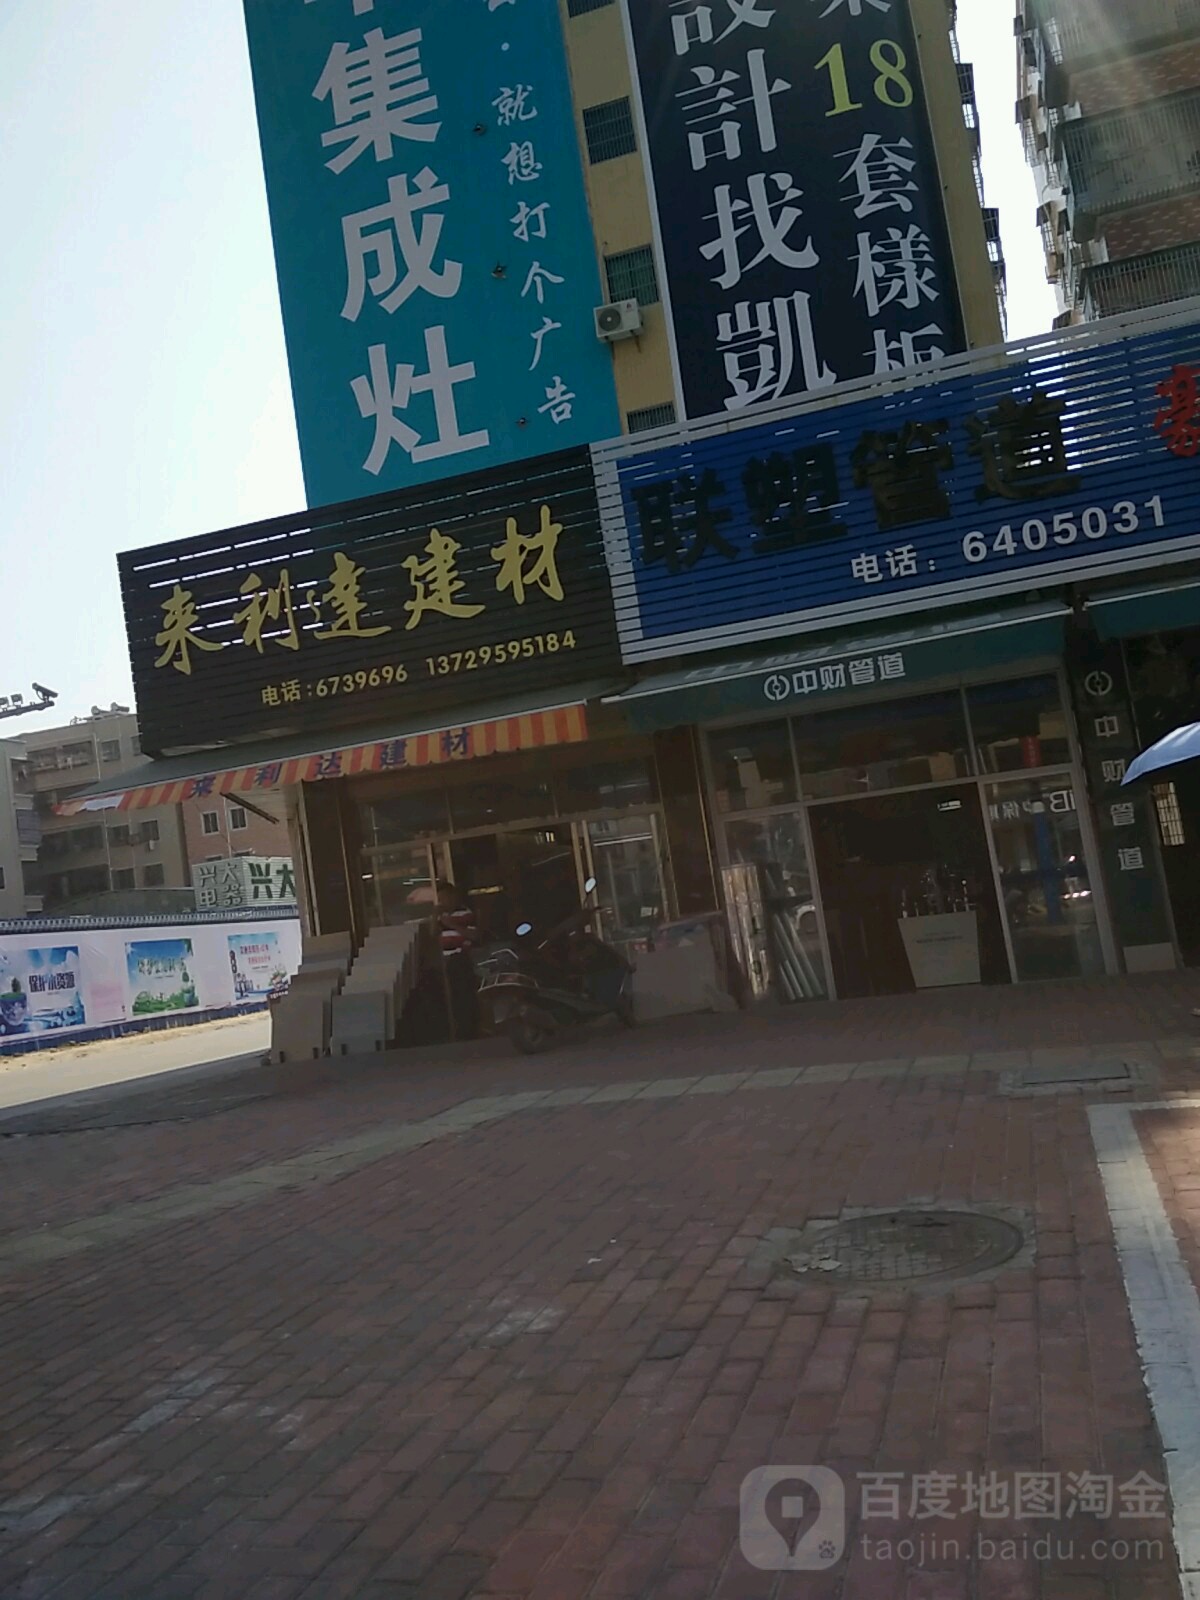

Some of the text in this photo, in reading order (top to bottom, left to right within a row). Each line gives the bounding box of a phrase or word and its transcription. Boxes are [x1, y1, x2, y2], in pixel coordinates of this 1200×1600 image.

[298, 0, 490, 475] 集成灶
[426, 630, 577, 677] 13729595184
[792, 652, 907, 694] 中财管道
[1094, 715, 1144, 871] 中财管道
